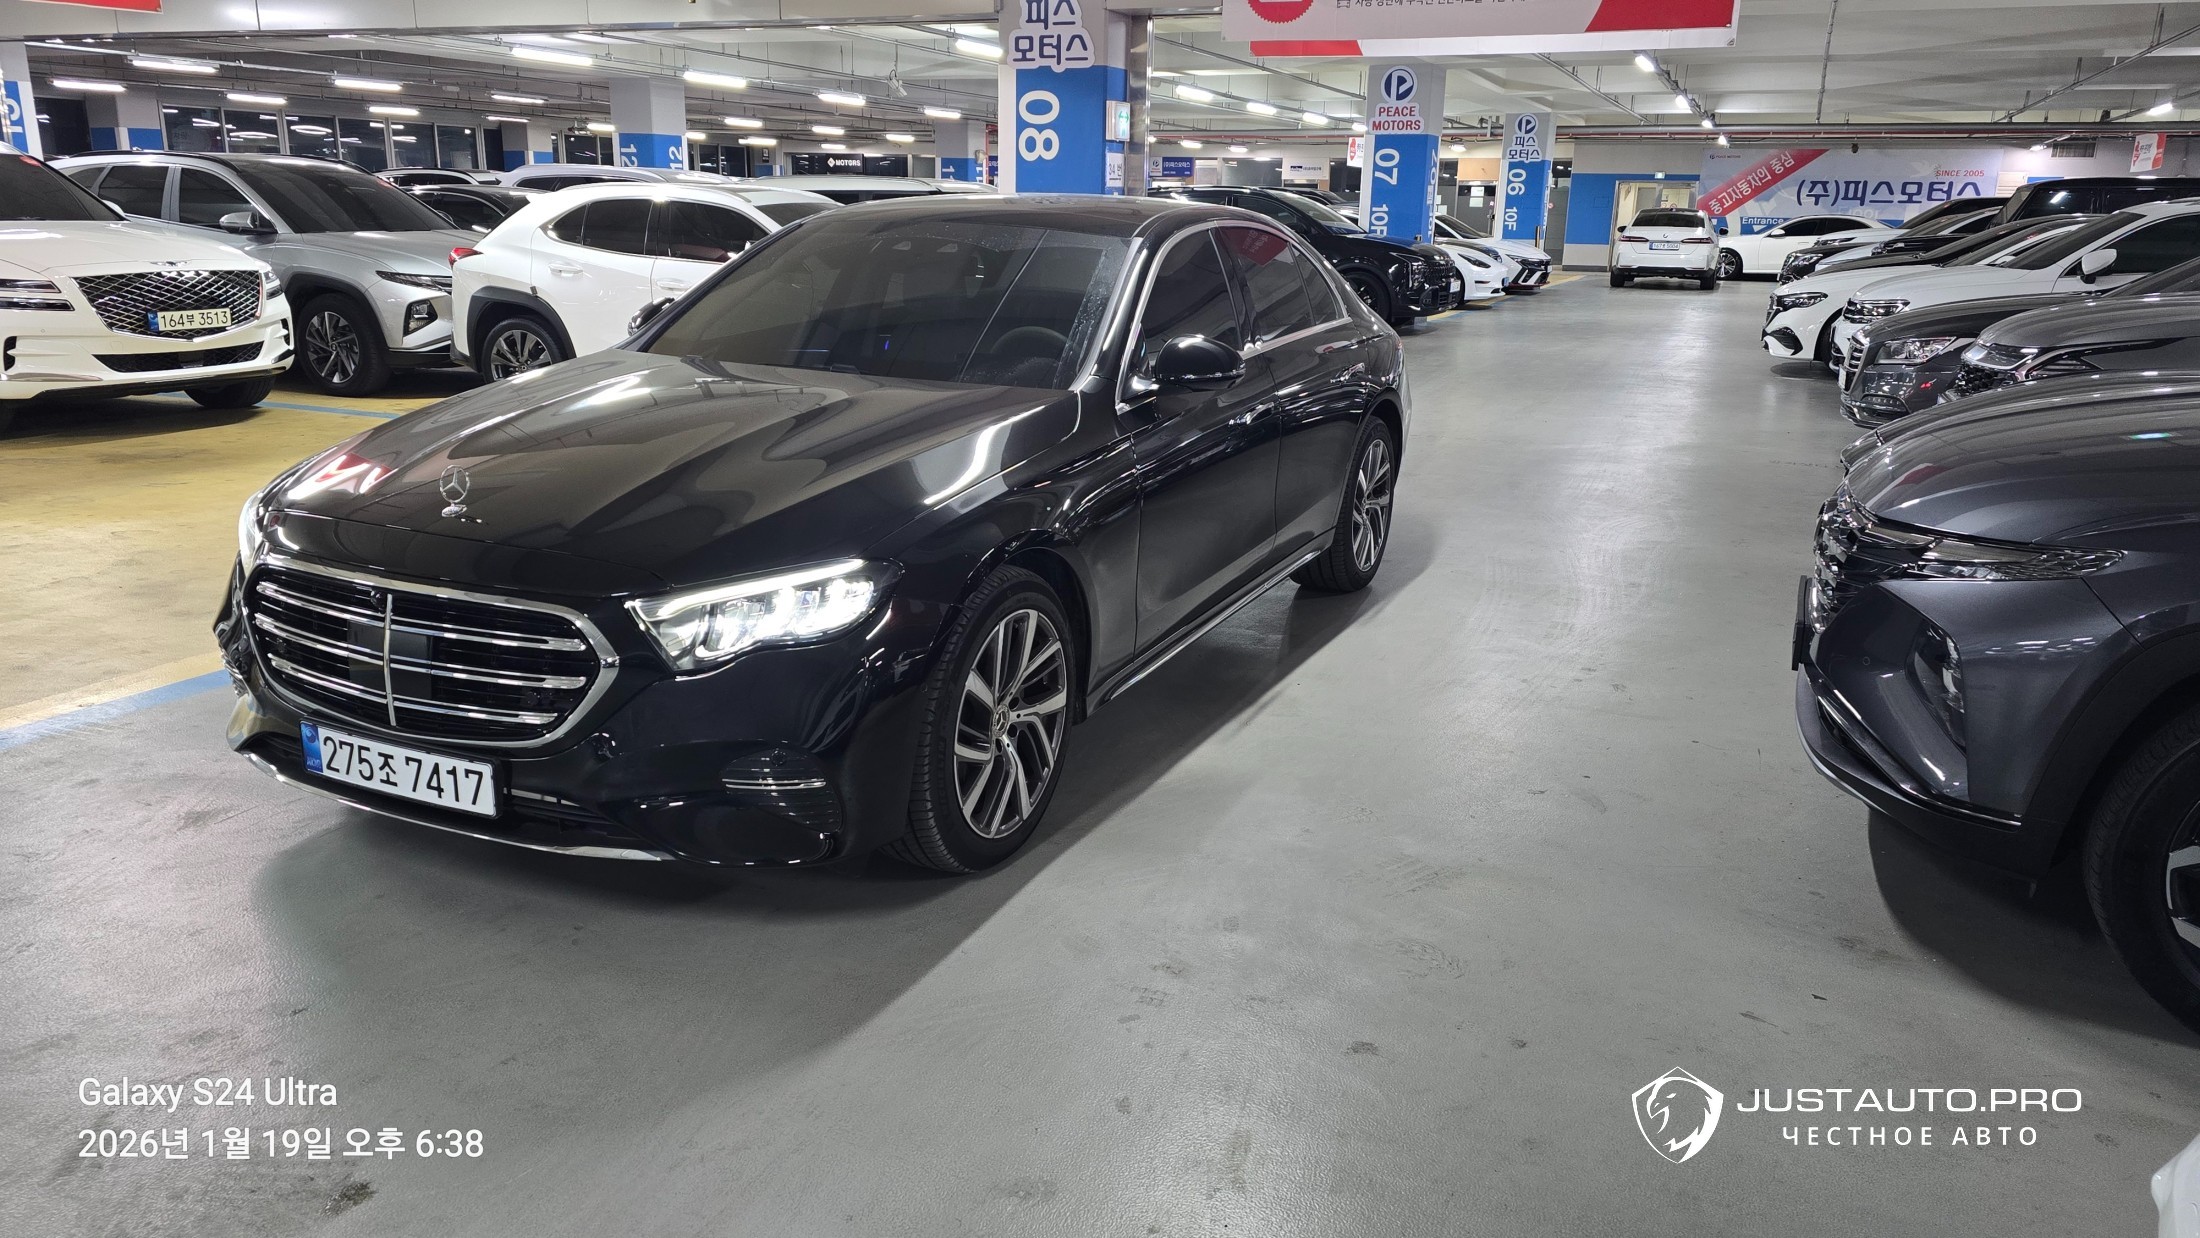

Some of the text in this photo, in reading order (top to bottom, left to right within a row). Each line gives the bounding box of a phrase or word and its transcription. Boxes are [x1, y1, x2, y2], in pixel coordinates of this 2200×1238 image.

[1025, 0, 1076, 31] 피스
[1012, 33, 1089, 66] 모터스
[1378, 106, 1416, 117] PEACE
[1018, 89, 1060, 162] 08
[1371, 119, 1421, 131] MOTORS
[1514, 136, 1536, 148] 피스
[620, 143, 638, 167] 12
[668, 145, 683, 170] 12
[835, 159, 861, 167] MOTORS
[1374, 148, 1400, 186] 07
[1507, 149, 1540, 161] 모터스
[1507, 168, 1527, 196] 06
[1708, 150, 1795, 215] 중고자동차의 중심
[1936, 169, 1985, 178] SINCE 2005
[1796, 179, 1982, 207] (주)피스모터스
[1504, 206, 1518, 231] 10F
[1742, 216, 1784, 225] Entrance
[160, 310, 229, 328] 164부 3513
[322, 735, 484, 806] 275조 7417
